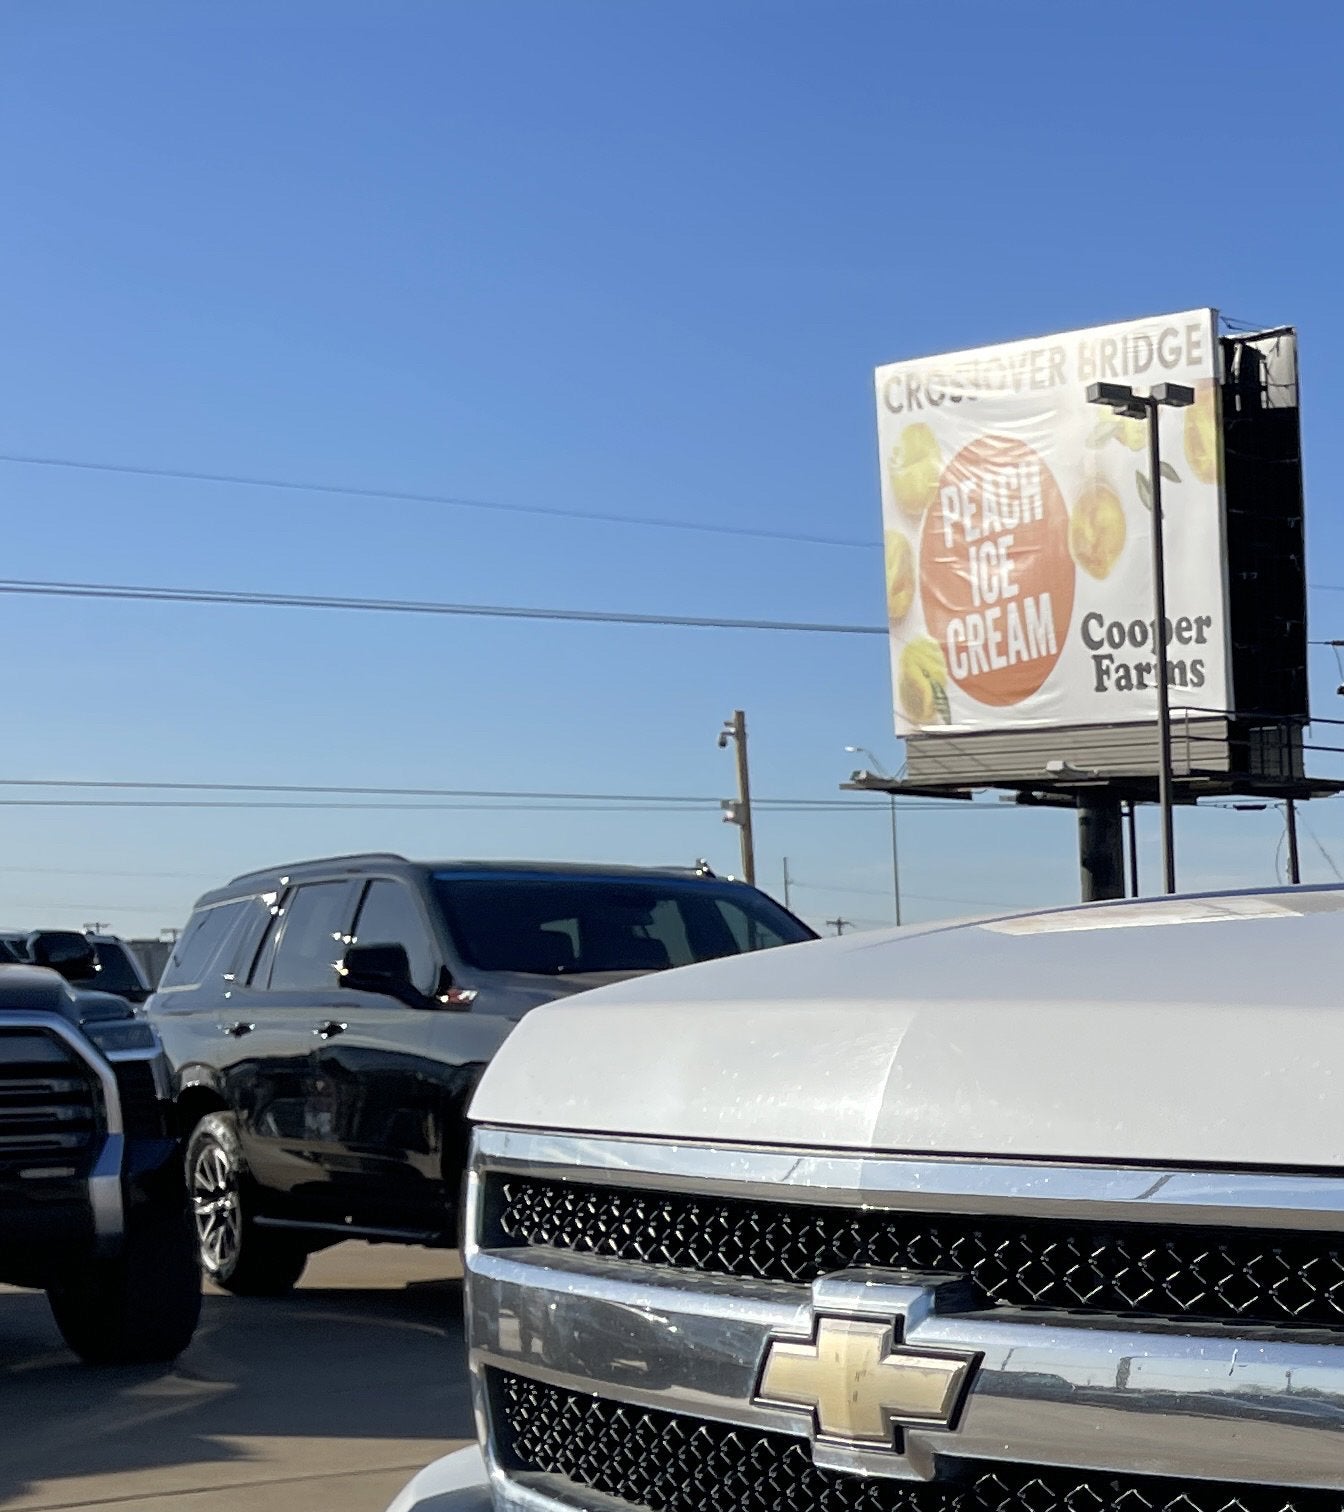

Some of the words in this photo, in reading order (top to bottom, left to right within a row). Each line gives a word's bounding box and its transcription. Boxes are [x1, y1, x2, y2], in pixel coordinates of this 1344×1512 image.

[1077, 323, 1202, 383] BRIDGE
[940, 459, 1044, 548] PEACH
[968, 534, 1020, 608] ICE
[946, 592, 1058, 681] CREAM
[1081, 611, 1211, 656] Cooper
[1091, 653, 1206, 693] Farms
